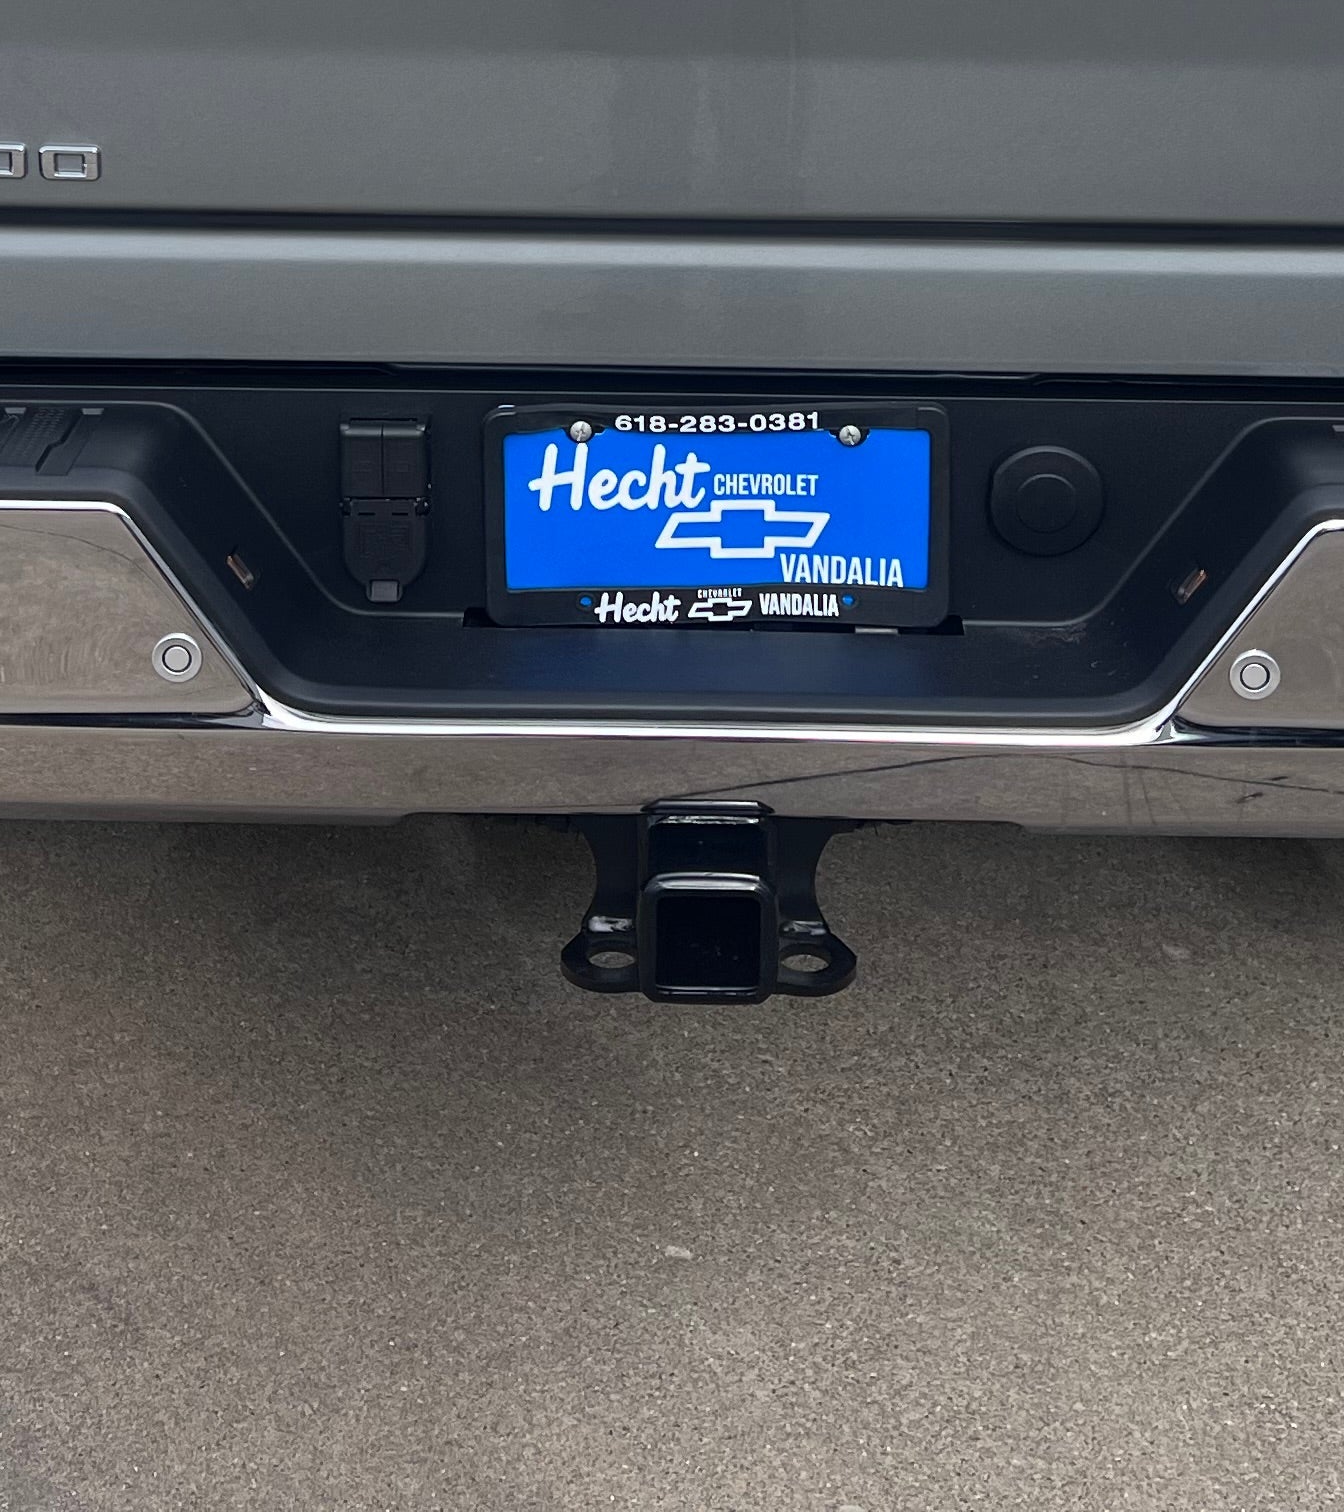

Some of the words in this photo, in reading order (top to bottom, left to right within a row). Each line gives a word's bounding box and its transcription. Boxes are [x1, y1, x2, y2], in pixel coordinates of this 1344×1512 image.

[614, 411, 820, 434] 618-283-0381
[528, 442, 712, 512] Hecht
[713, 473, 819, 498] CHEVROLET
[779, 553, 905, 589] VANDALIA
[594, 591, 681, 624] Hecht
[697, 587, 742, 599] CHEVROLET
[758, 591, 840, 618] VANDALIA
